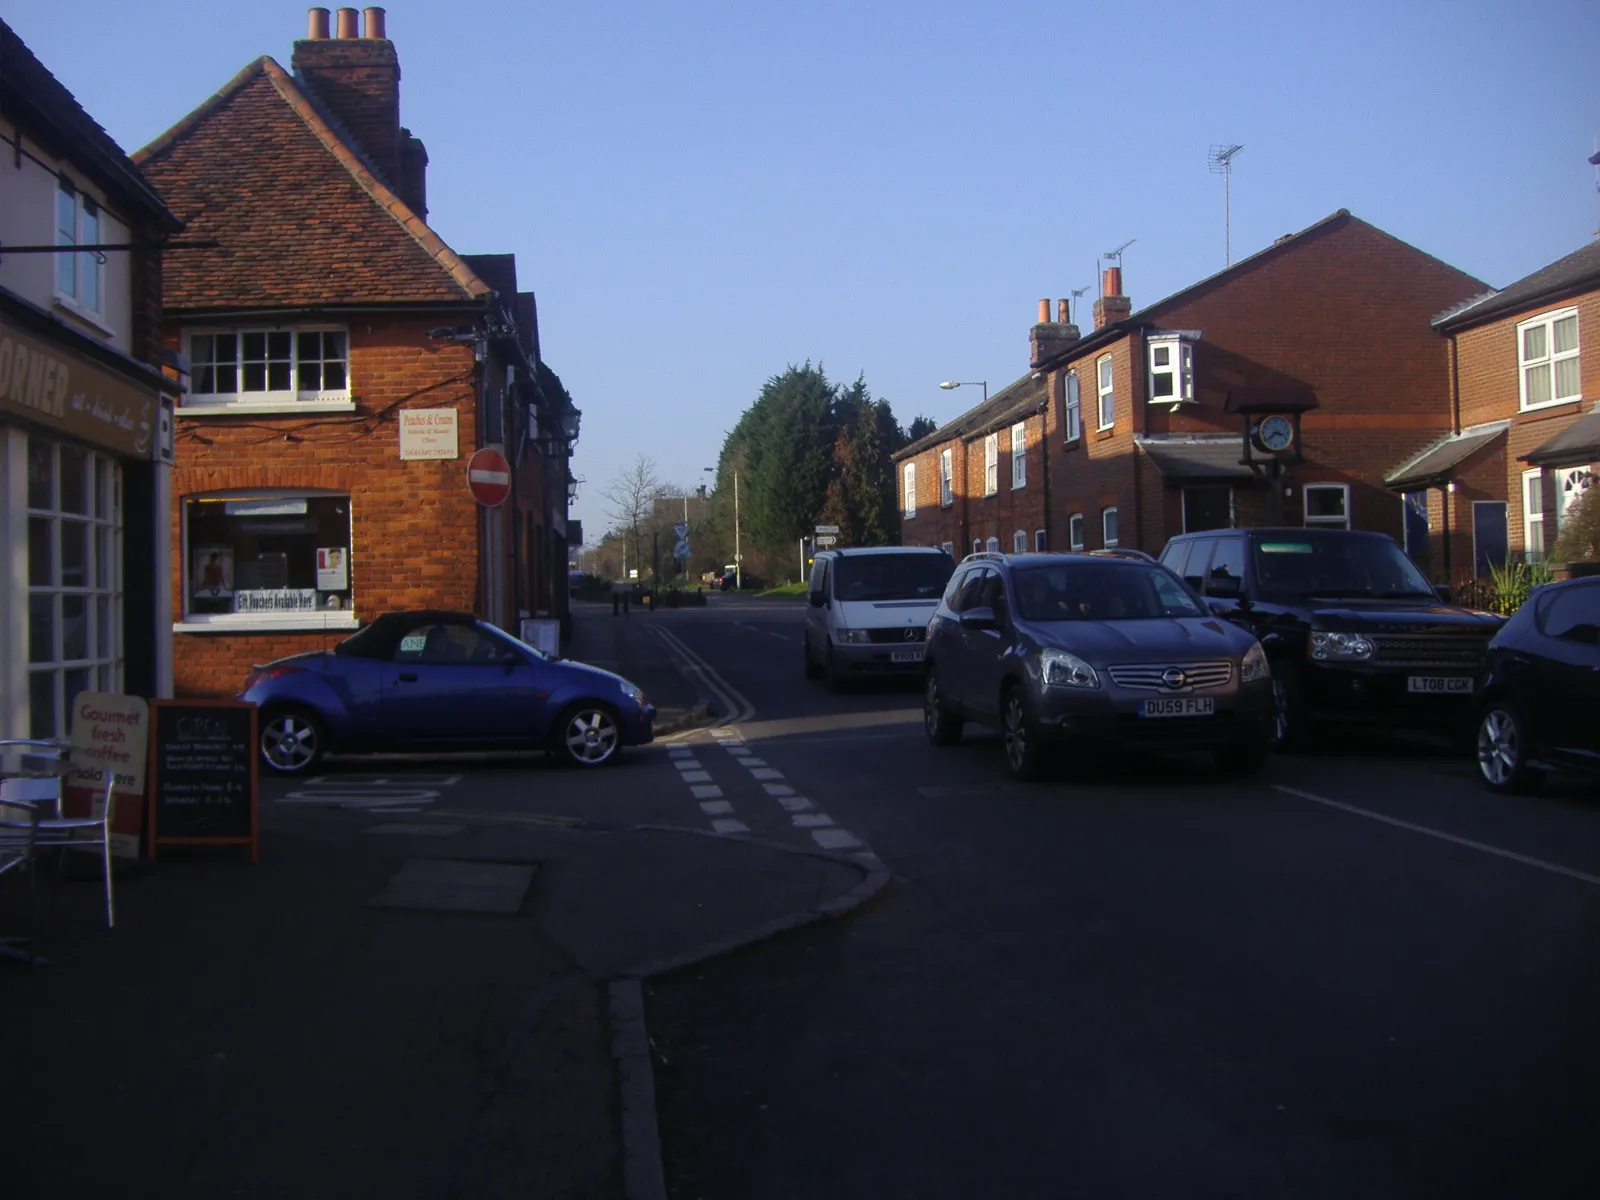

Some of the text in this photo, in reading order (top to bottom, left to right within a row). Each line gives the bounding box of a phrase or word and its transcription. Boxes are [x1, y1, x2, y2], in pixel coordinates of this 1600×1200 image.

[238, 594, 248, 609] Gift
[249, 594, 273, 610] Vouchers
[299, 593, 312, 608] Here
[80, 704, 141, 726] Gourmet
[1147, 698, 1212, 714] DU59 FLH
[92, 724, 126, 743] fresh
[85, 745, 131, 763] coffee
[76, 766, 136, 786] sold ere
